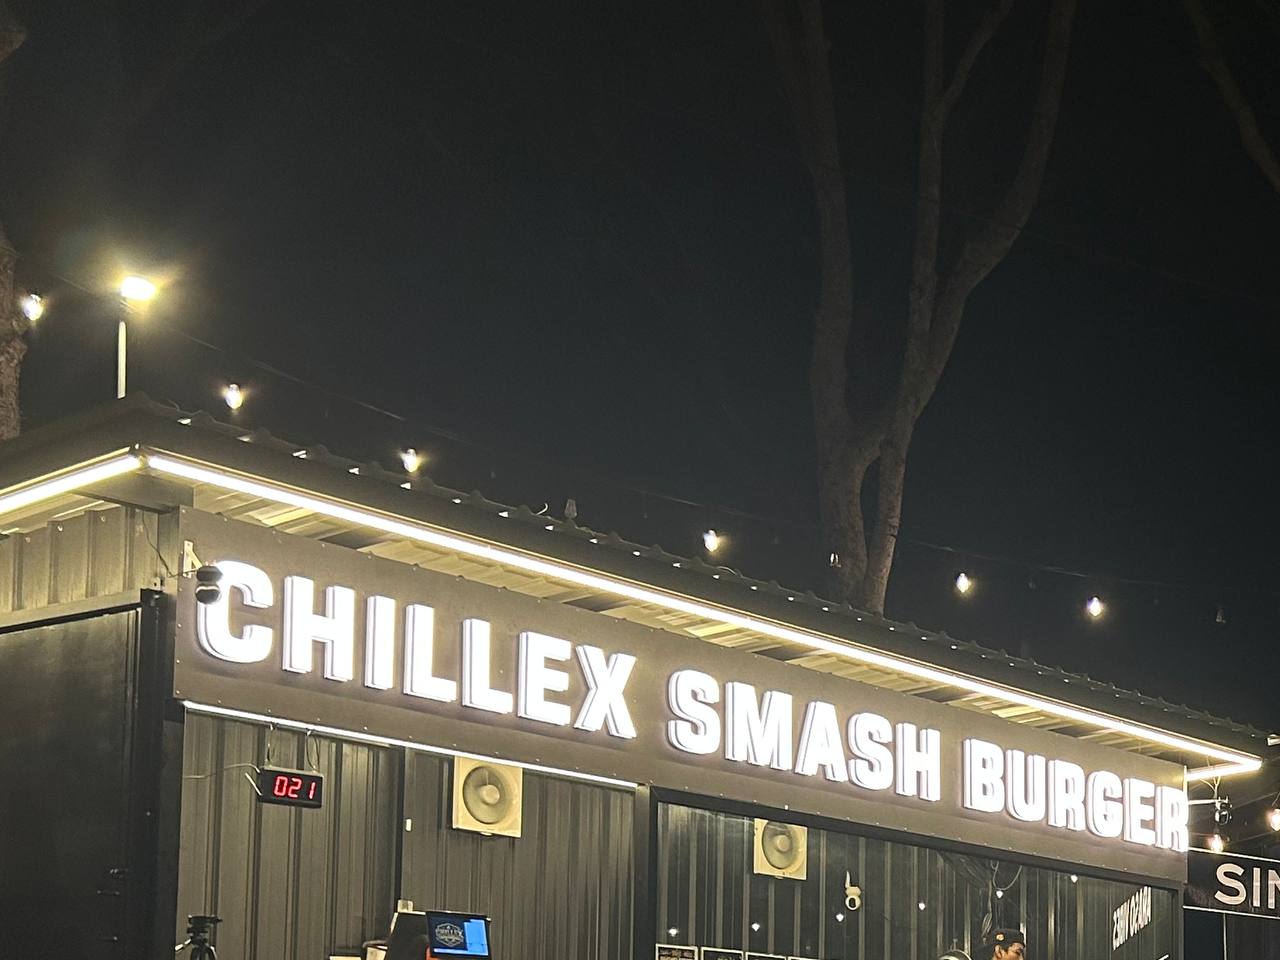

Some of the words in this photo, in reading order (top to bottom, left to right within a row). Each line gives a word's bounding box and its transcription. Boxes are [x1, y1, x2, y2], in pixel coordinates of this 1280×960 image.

[197, 560, 638, 741] CHILLEX
[667, 669, 942, 802] SMASH
[963, 738, 1189, 852] BURGER
[274, 776, 316, 799] 021
